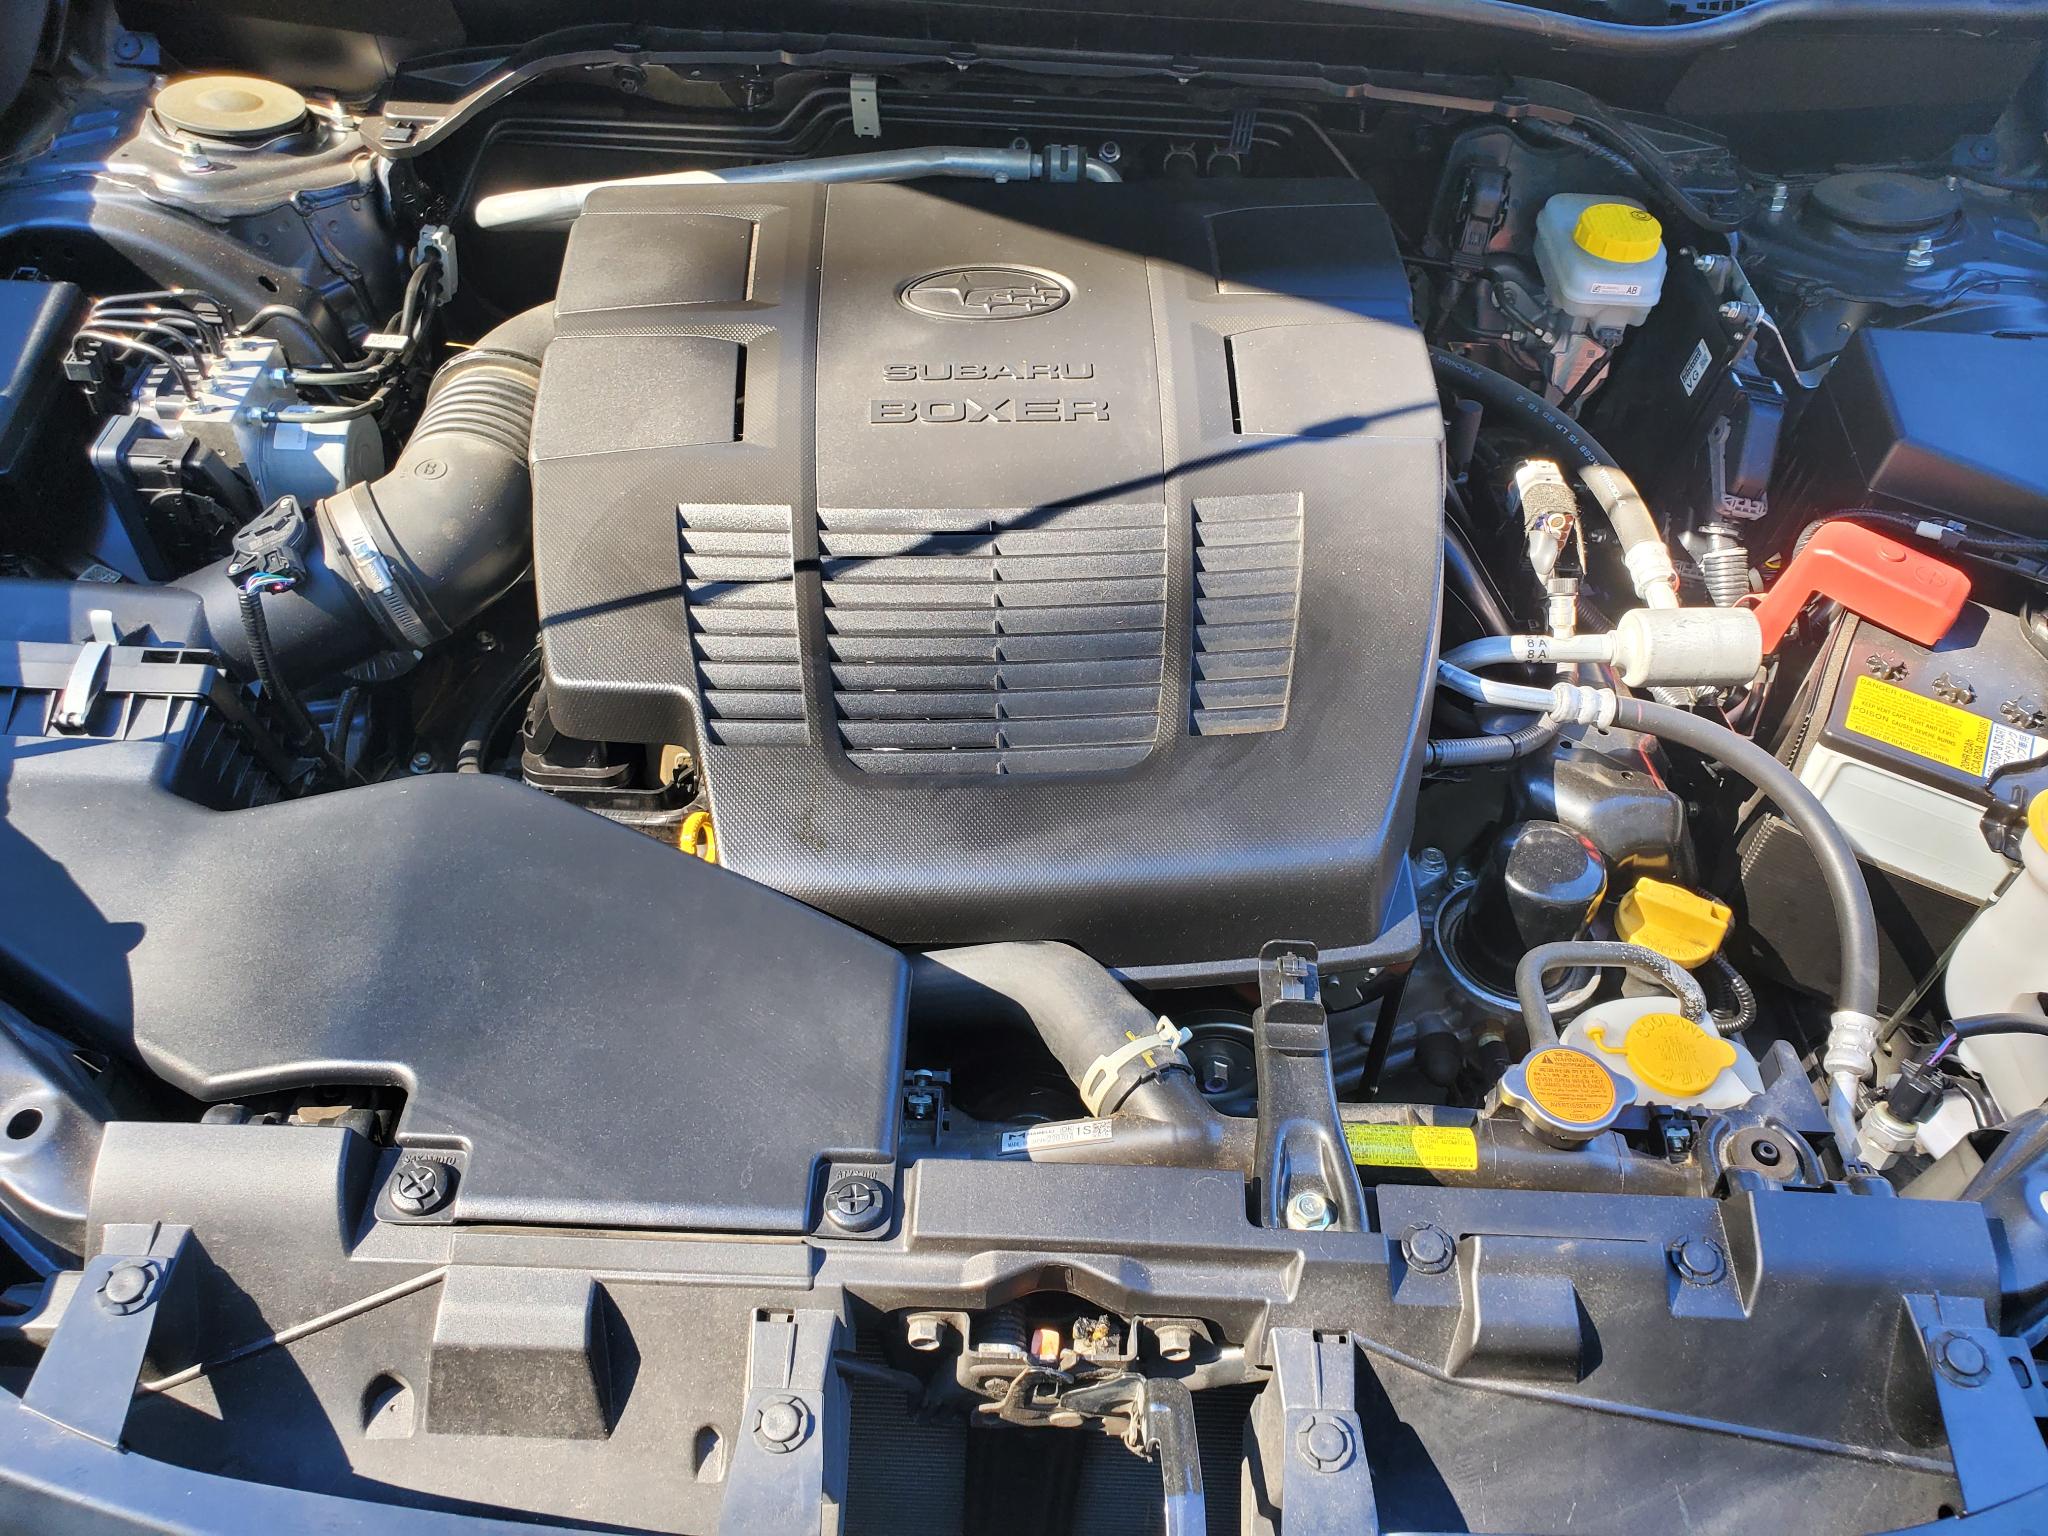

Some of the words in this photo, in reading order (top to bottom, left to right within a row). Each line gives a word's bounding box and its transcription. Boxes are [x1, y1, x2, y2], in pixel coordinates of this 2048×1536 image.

[1626, 286, 1638, 294] AB
[883, 362, 1094, 381] SUBARU
[1686, 370, 1700, 388] VG
[870, 398, 1110, 424] BOXER
[1860, 679, 1897, 694] DANGER
[1853, 705, 1889, 722] POISON
[1891, 719, 1914, 731] CAUSES
[1891, 711, 1906, 720] CAPS
[1925, 723, 1937, 731] AND
[1939, 728, 1956, 738] LEVEL
[1994, 726, 2007, 745] START
[1891, 738, 1910, 748] REACH
[1920, 749, 1950, 762] CHILDREN
